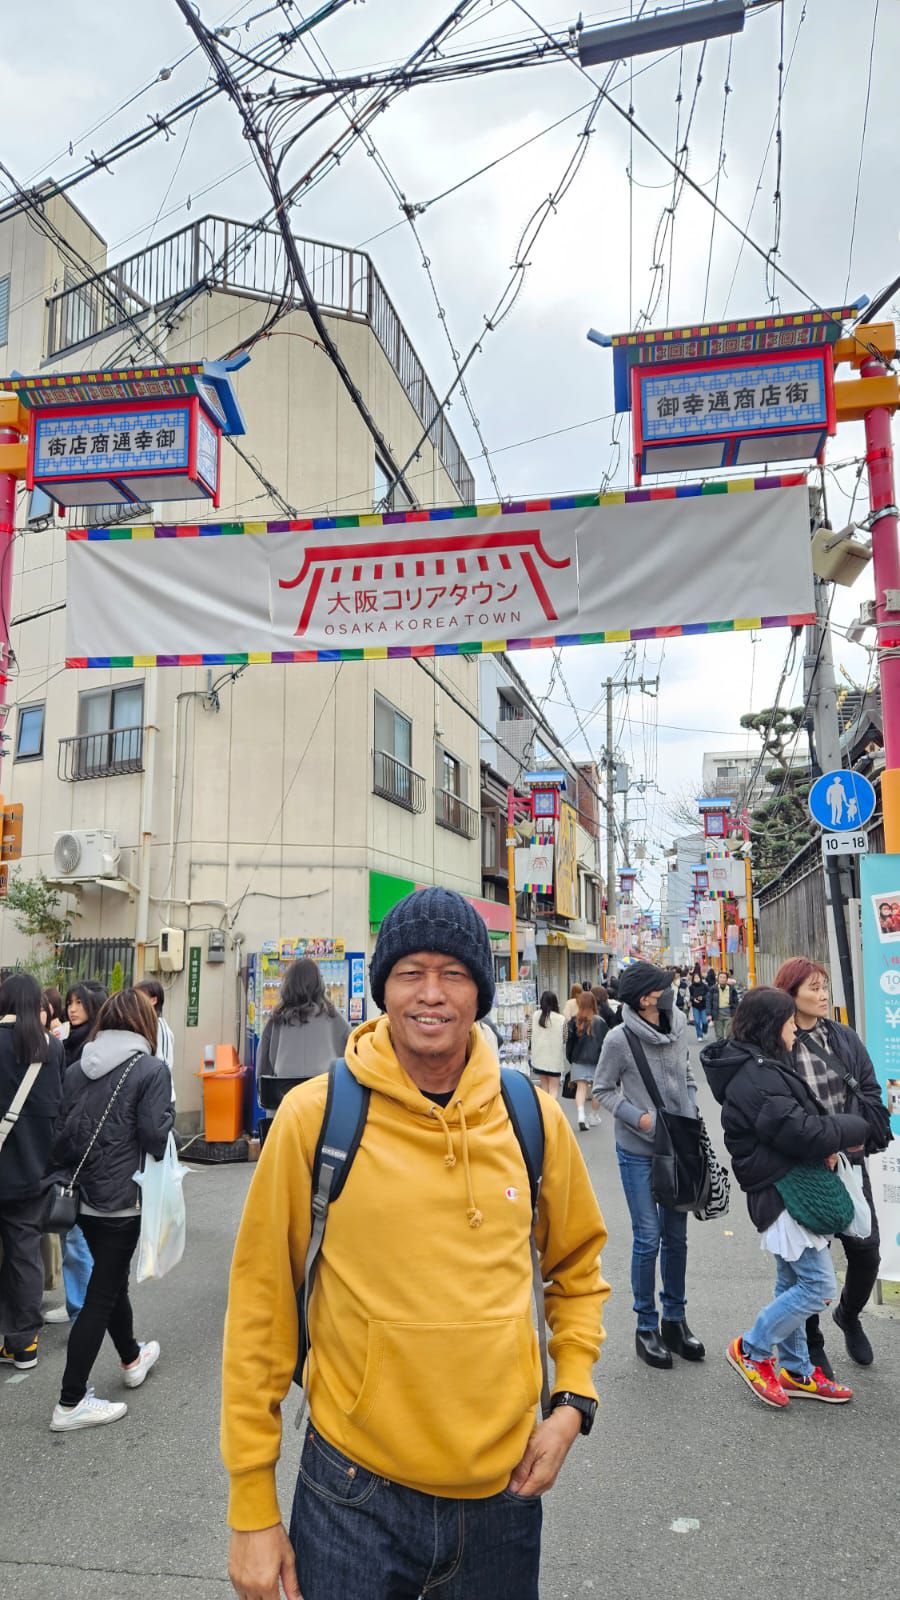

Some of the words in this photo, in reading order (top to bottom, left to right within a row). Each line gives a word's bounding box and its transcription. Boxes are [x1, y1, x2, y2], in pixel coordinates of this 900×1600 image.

[656, 382, 809, 418] 御幸通商店街
[327, 580, 518, 615] 大阪コリアタウン
[324, 621, 387, 636] OSAKA
